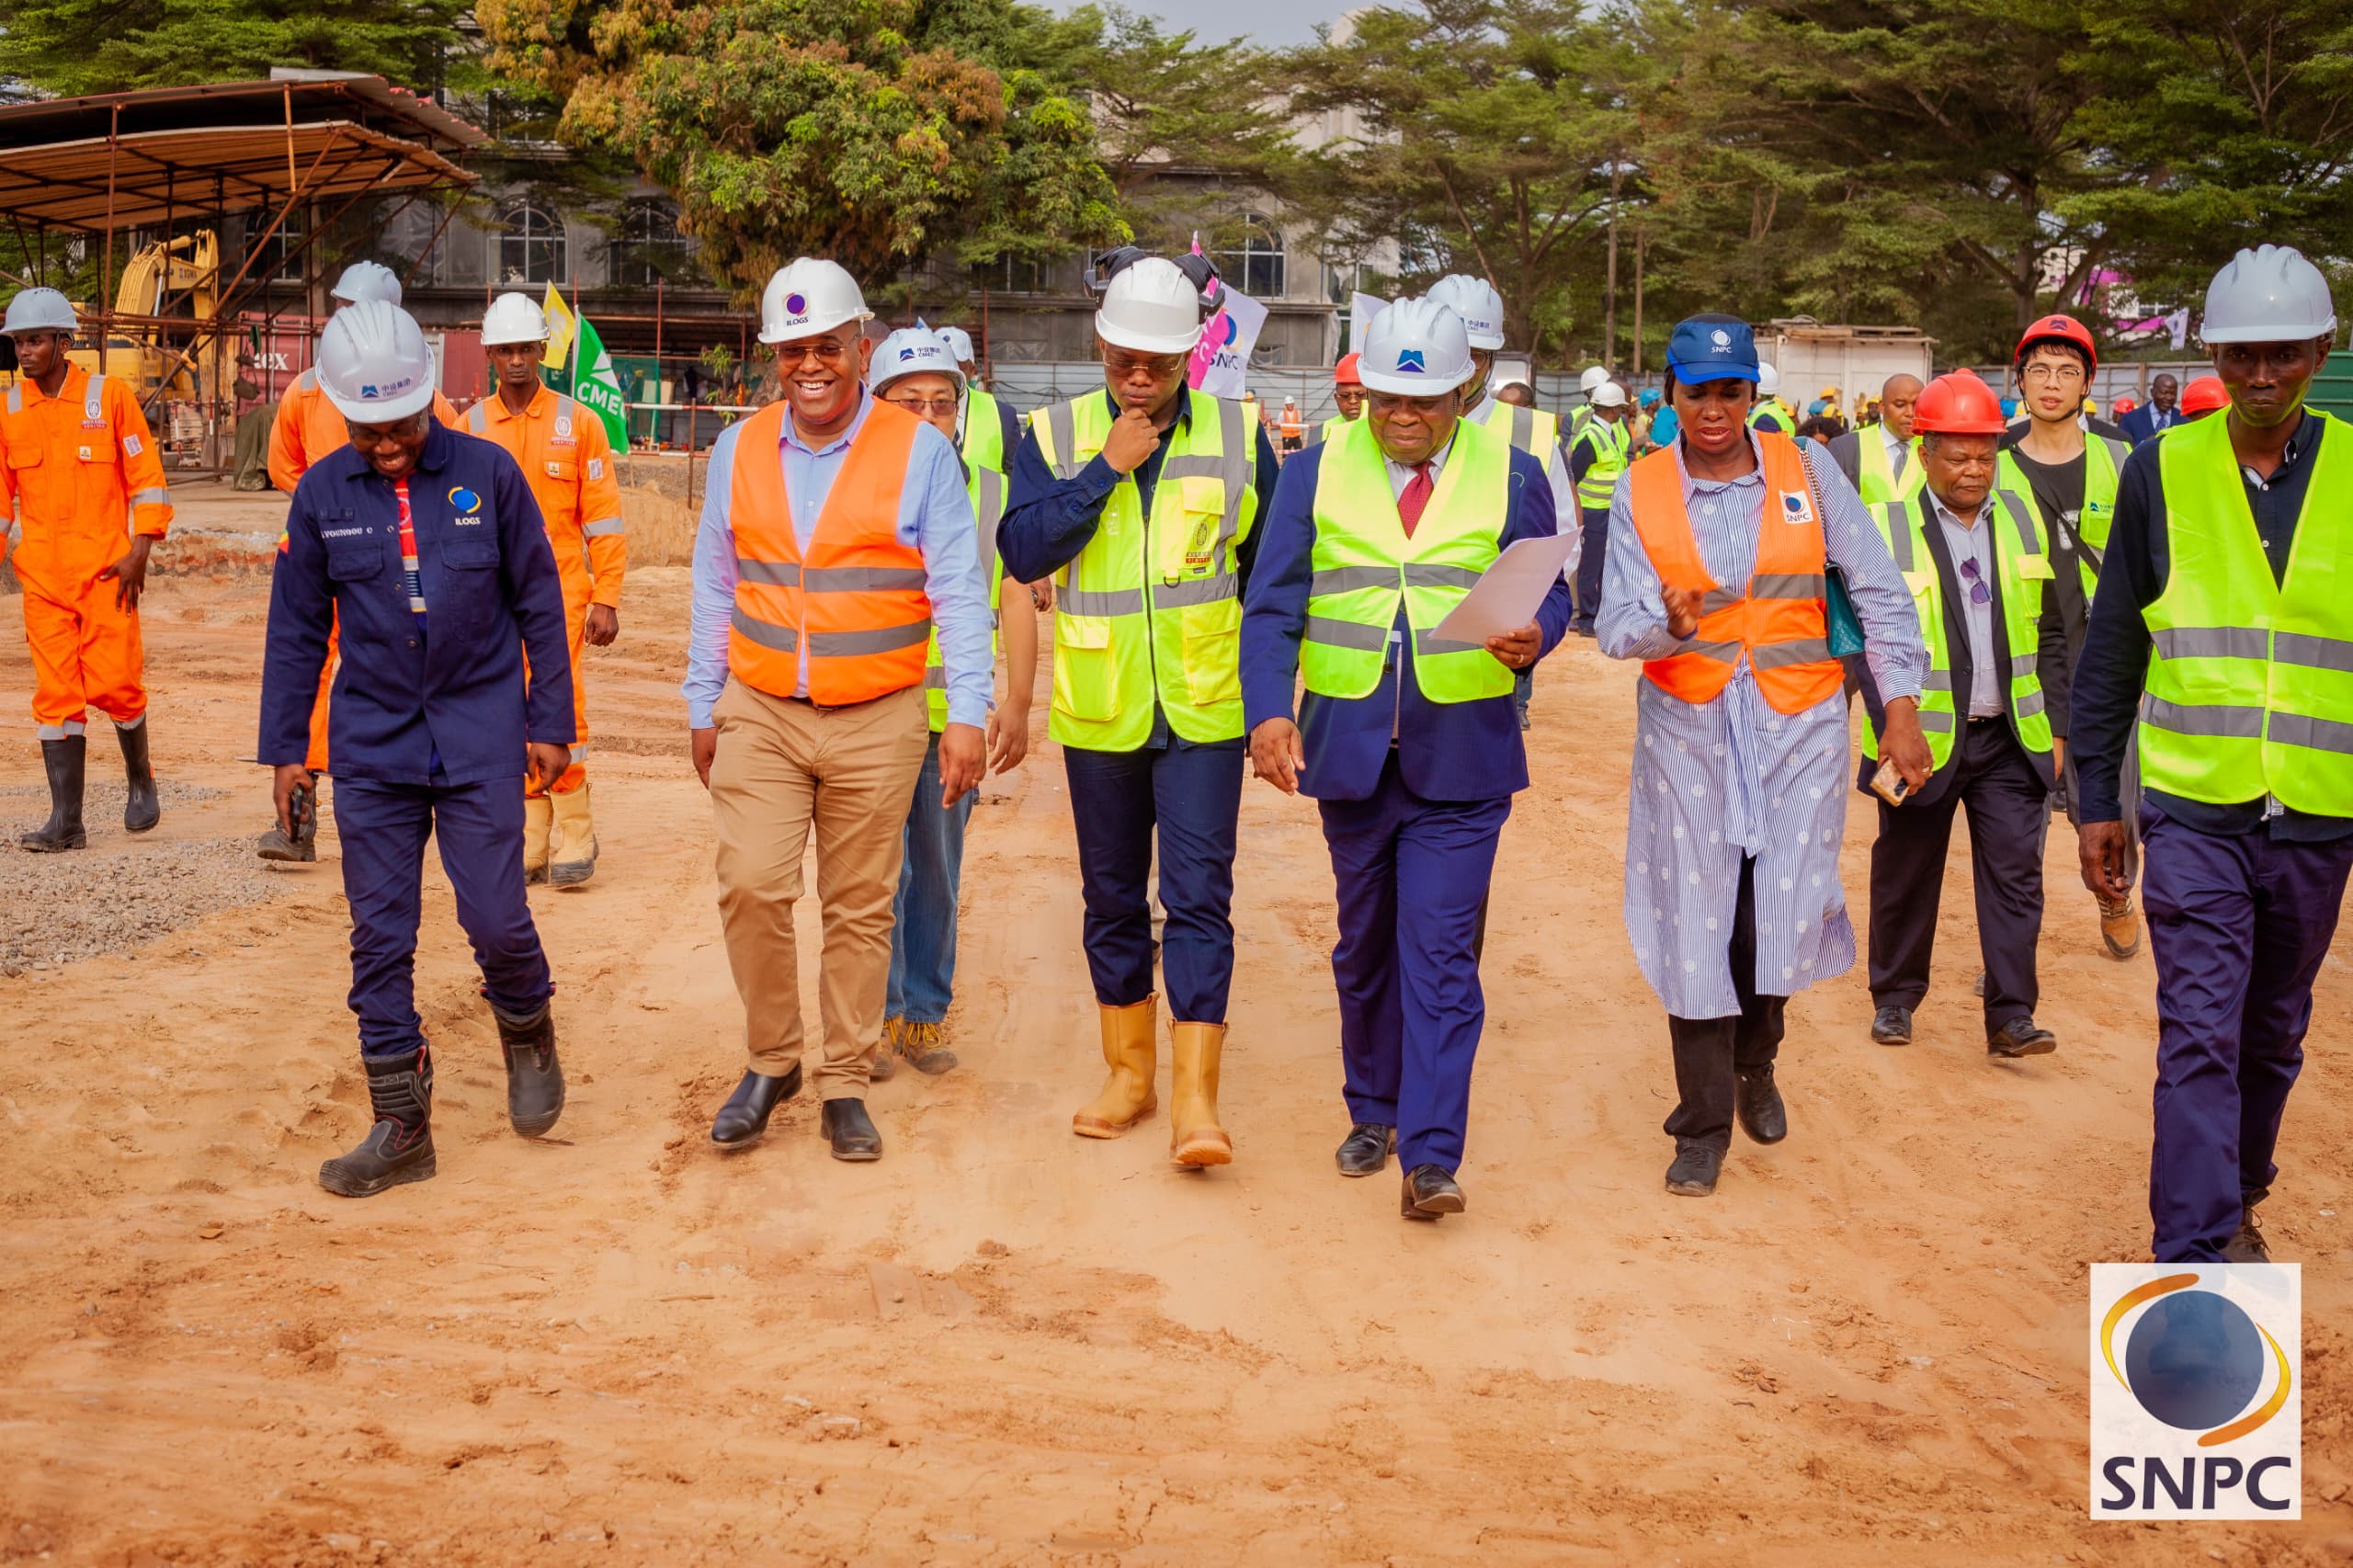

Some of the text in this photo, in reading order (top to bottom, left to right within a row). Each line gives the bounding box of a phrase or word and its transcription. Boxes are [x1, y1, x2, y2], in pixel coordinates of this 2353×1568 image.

[787, 316, 809, 326] ILOGS
[455, 517, 481, 526] ILOGS
[1786, 513, 1810, 522] SNPC
